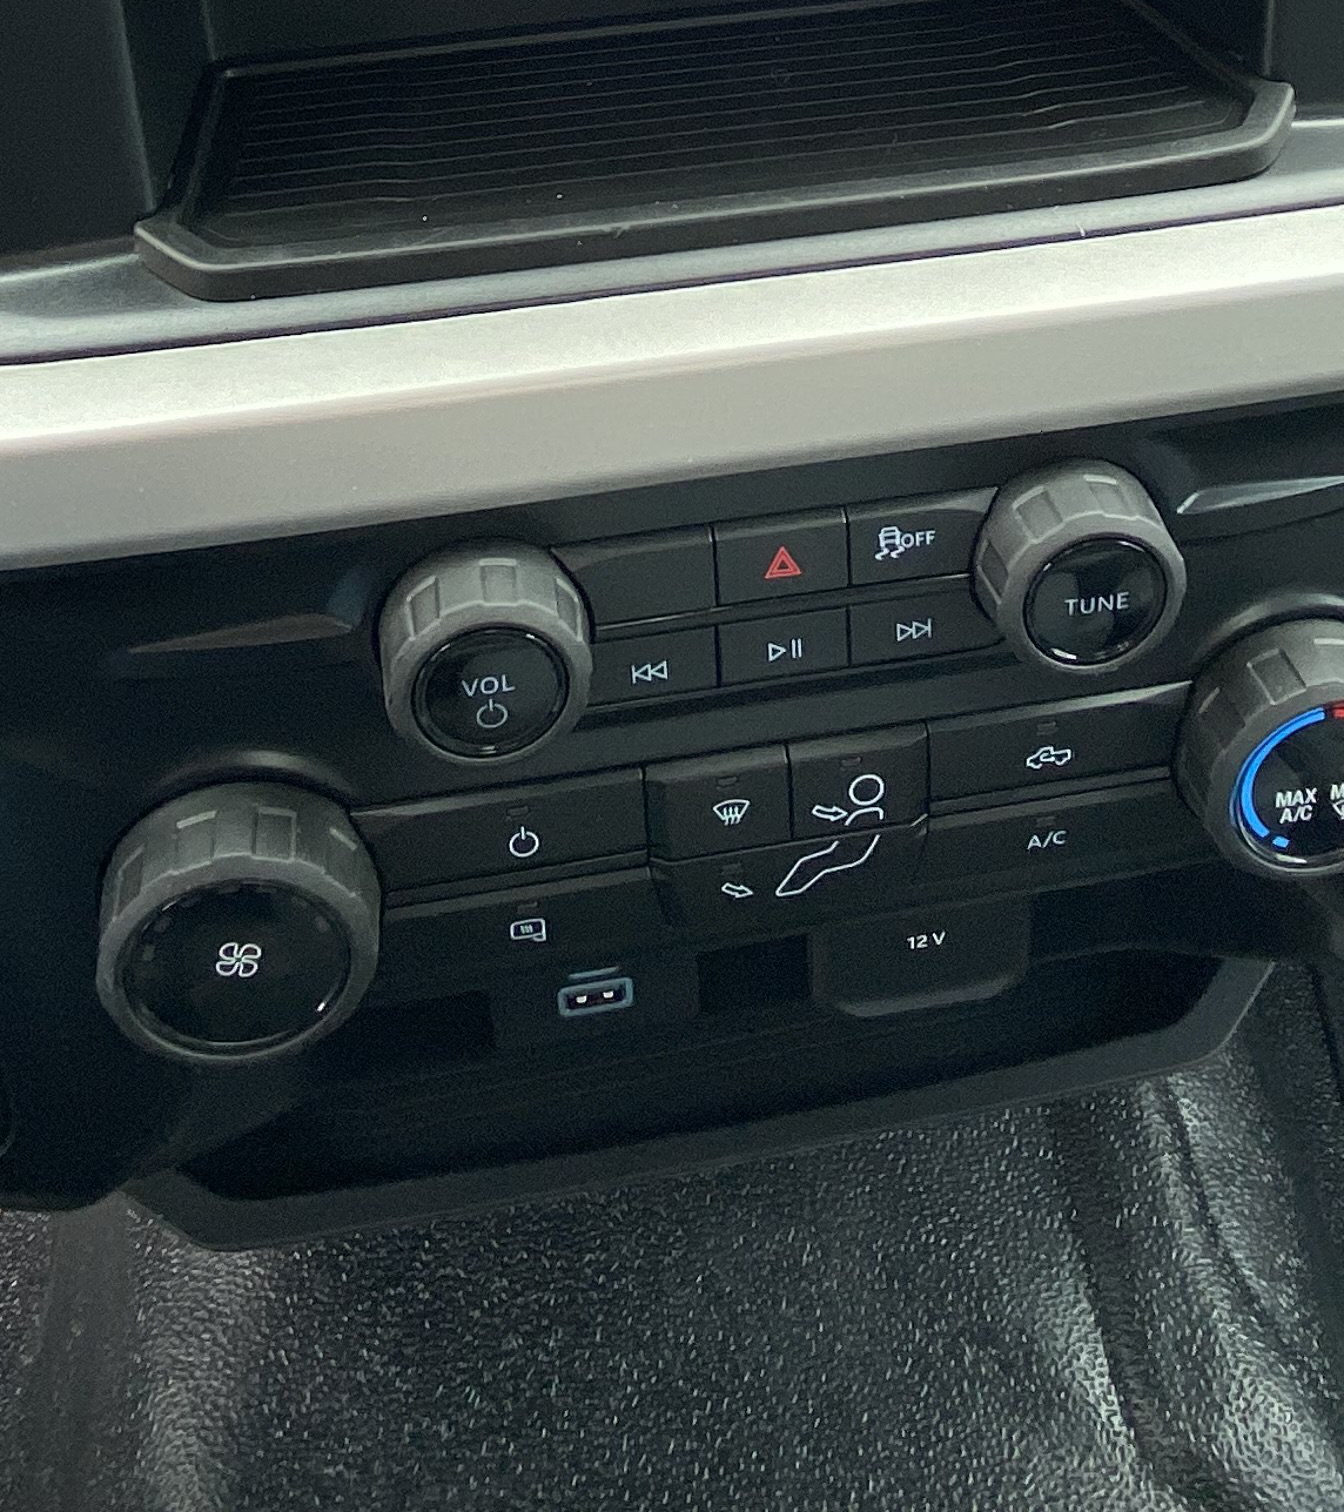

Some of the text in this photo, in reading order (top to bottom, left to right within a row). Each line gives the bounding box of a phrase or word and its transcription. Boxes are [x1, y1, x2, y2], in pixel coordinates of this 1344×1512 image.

[901, 528, 936, 551] OFF
[1064, 591, 1129, 617] TUNE
[460, 676, 516, 697] VOL
[1276, 787, 1317, 808] MAX
[1279, 804, 1313, 824] A/C
[1027, 830, 1067, 851] A/C
[906, 931, 947, 951] 12 V
